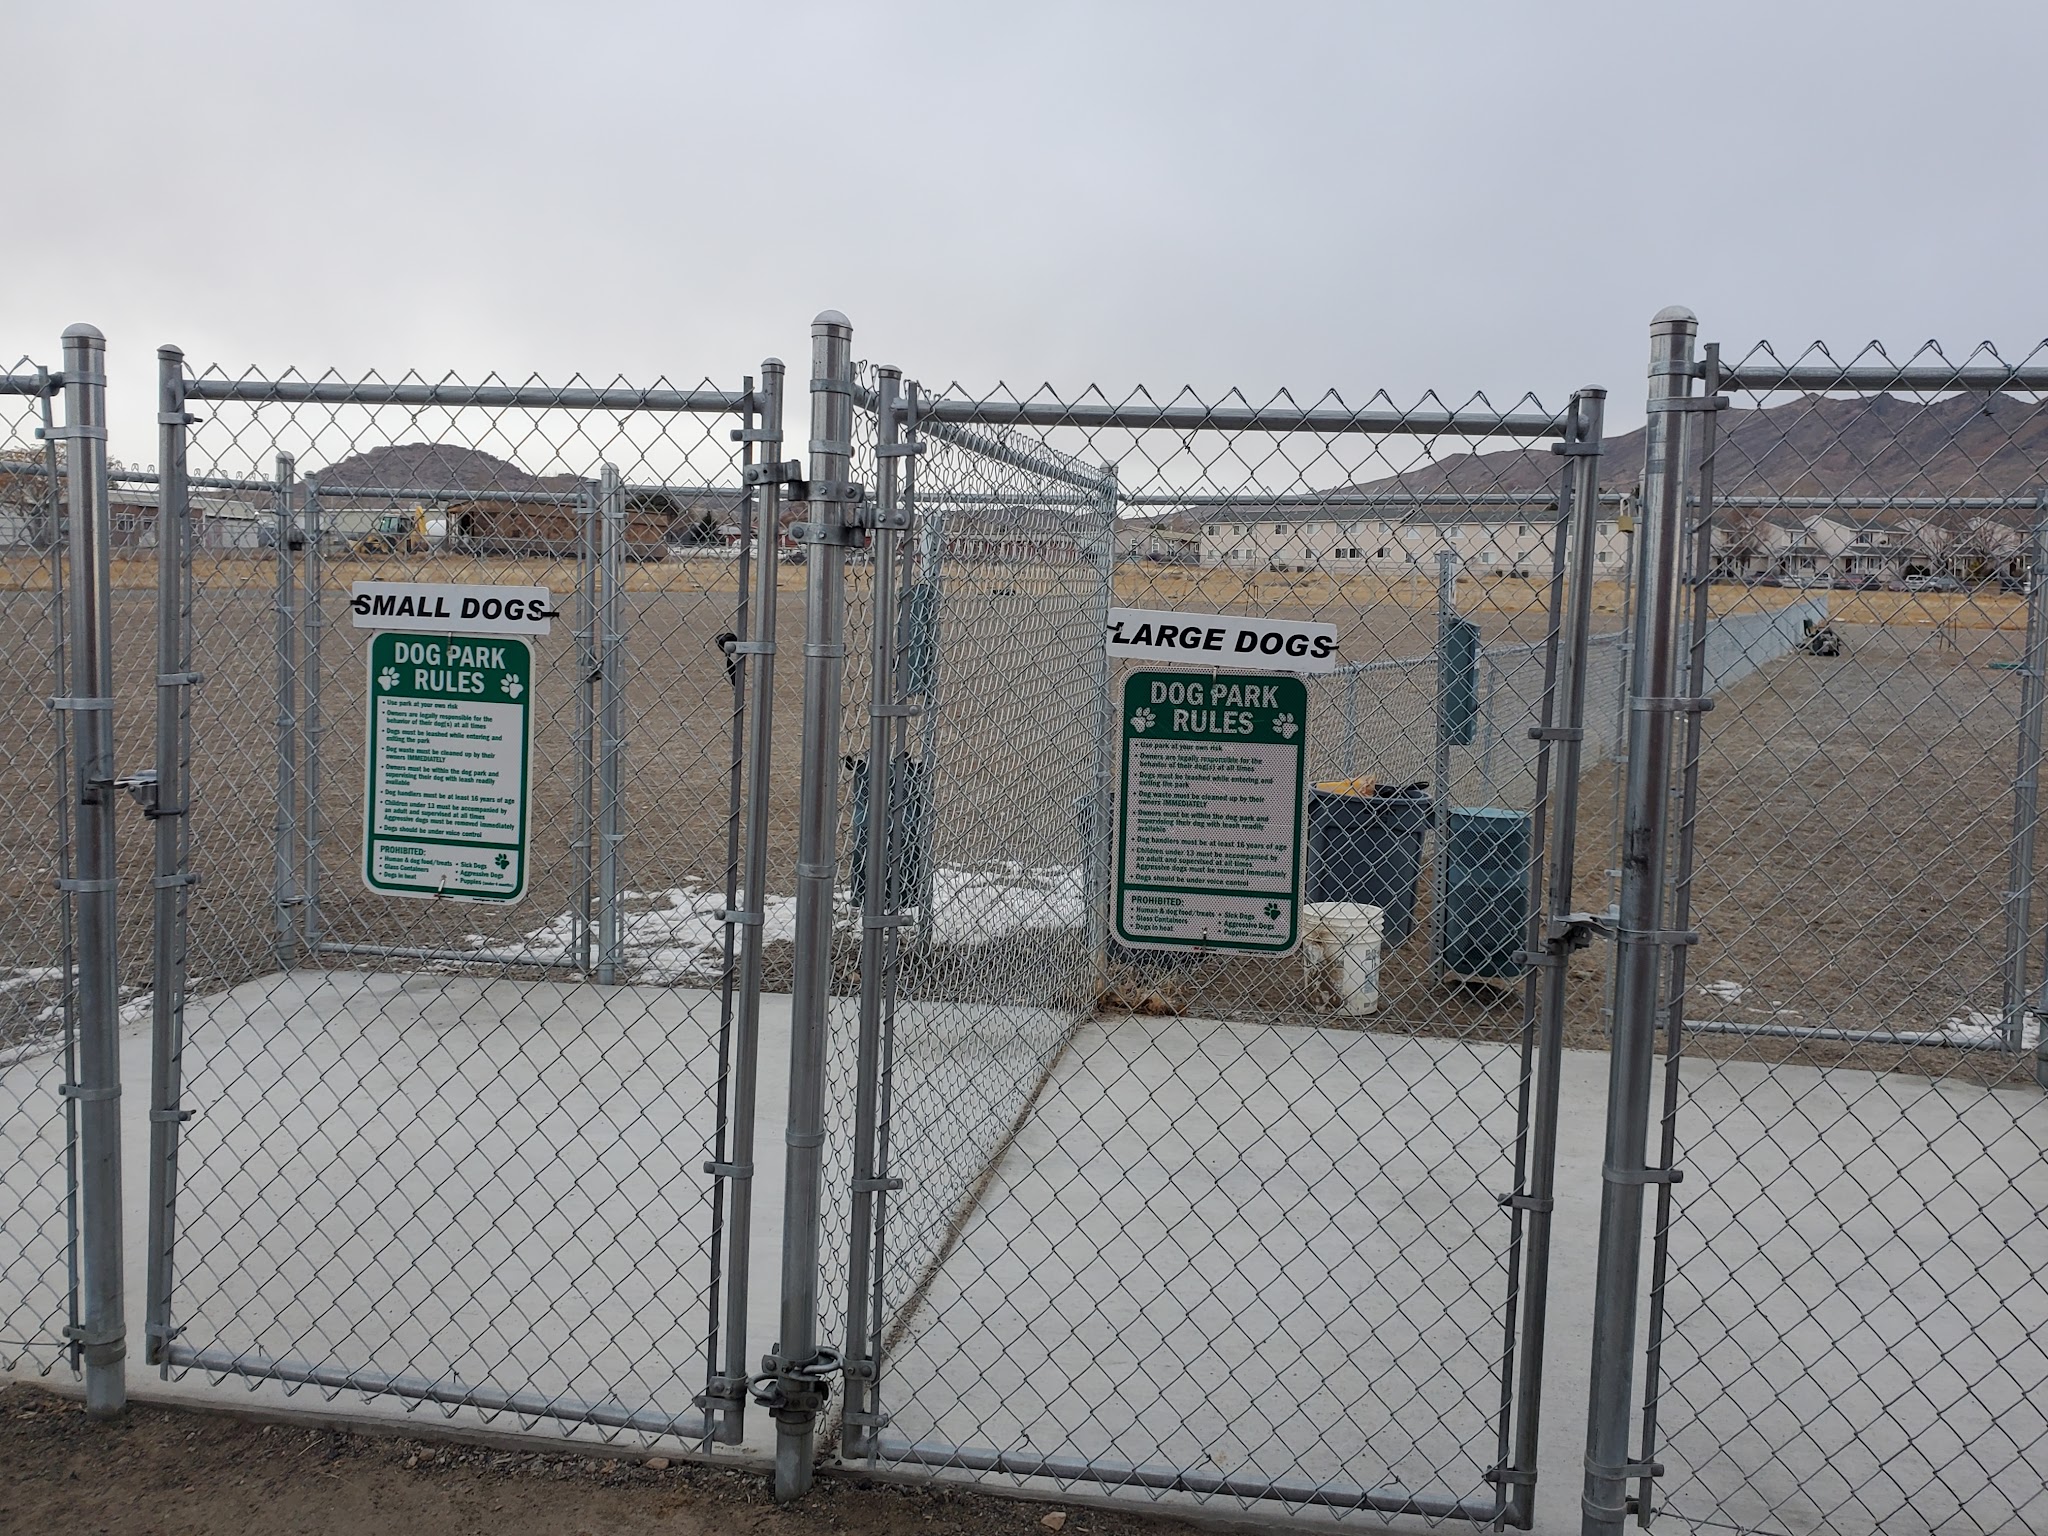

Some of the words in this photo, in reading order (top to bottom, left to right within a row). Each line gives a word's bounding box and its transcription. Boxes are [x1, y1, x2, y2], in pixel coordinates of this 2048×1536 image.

[354, 594, 450, 617] SMALL
[461, 598, 545, 621] DOGS
[1112, 621, 1226, 651] LARGE
[1234, 631, 1333, 659] DOGS
[395, 642, 440, 665] DOG
[447, 645, 506, 669] PARK
[414, 669, 485, 694] RULES
[1150, 681, 1204, 706] DOG
[1211, 683, 1279, 708] PARK
[419, 712, 437, 720] legally
[439, 713, 471, 722] responsible
[1173, 709, 1254, 734] RULES
[433, 720, 452, 728] dog(s)
[386, 735, 404, 743] exiting
[466, 733, 489, 741] entering
[407, 755, 445, 763] IMMEDIATELY
[385, 771, 416, 780] supervising
[421, 810, 451, 818] supervised
[460, 805, 499, 814] accompanied
[384, 814, 413, 823] Aggressive
[415, 816, 428, 824] dogs
[454, 819, 478, 827] removed
[479, 821, 514, 831] immediately
[379, 845, 426, 856] PROHIBITED:
[420, 859, 452, 868] food/treats
[384, 871, 396, 879] Dogs
[460, 869, 488, 878] Aggressive
[490, 872, 503, 880] Dogs
[460, 877, 481, 886] Puppies
